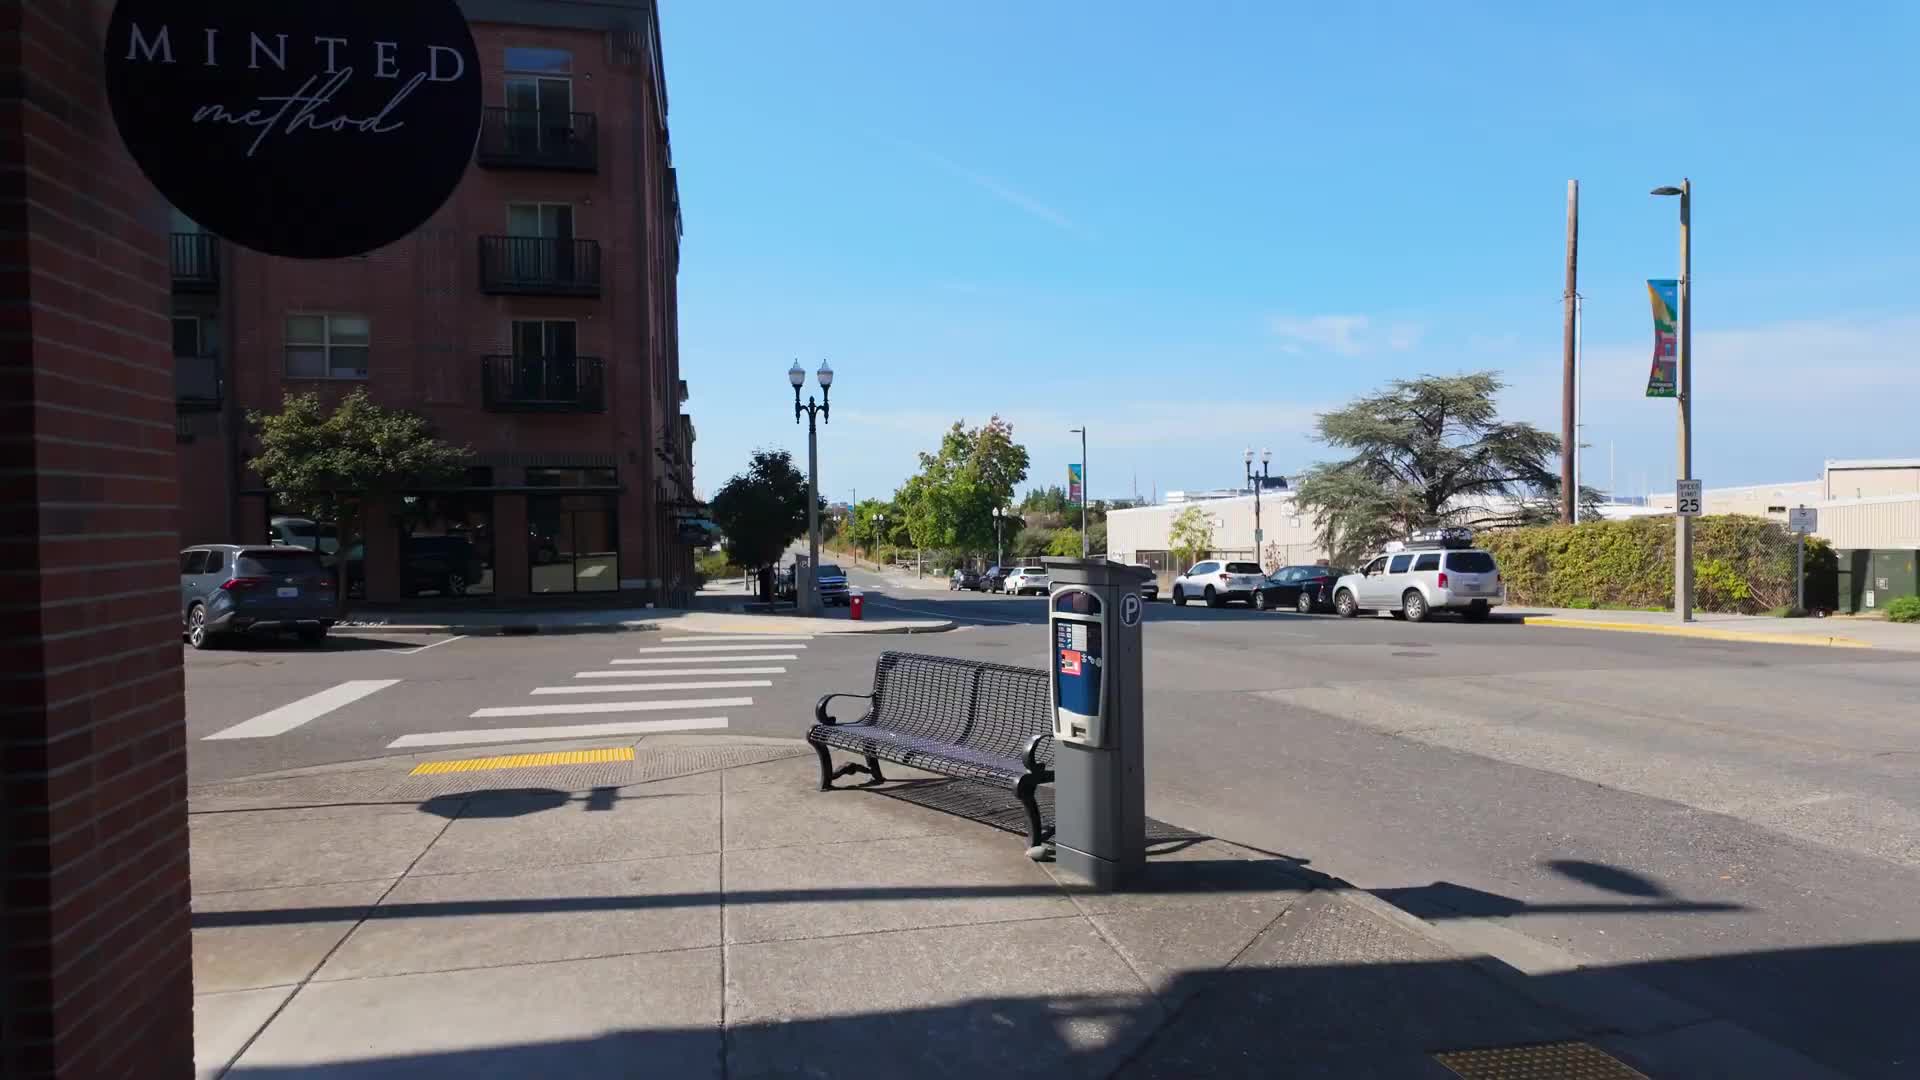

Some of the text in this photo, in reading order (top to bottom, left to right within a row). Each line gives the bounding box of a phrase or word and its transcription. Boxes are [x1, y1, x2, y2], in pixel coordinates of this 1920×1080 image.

[125, 22, 466, 82] MINTED
[191, 66, 427, 158] method
[1679, 498, 1699, 512] 25
[1126, 597, 1138, 622] P
